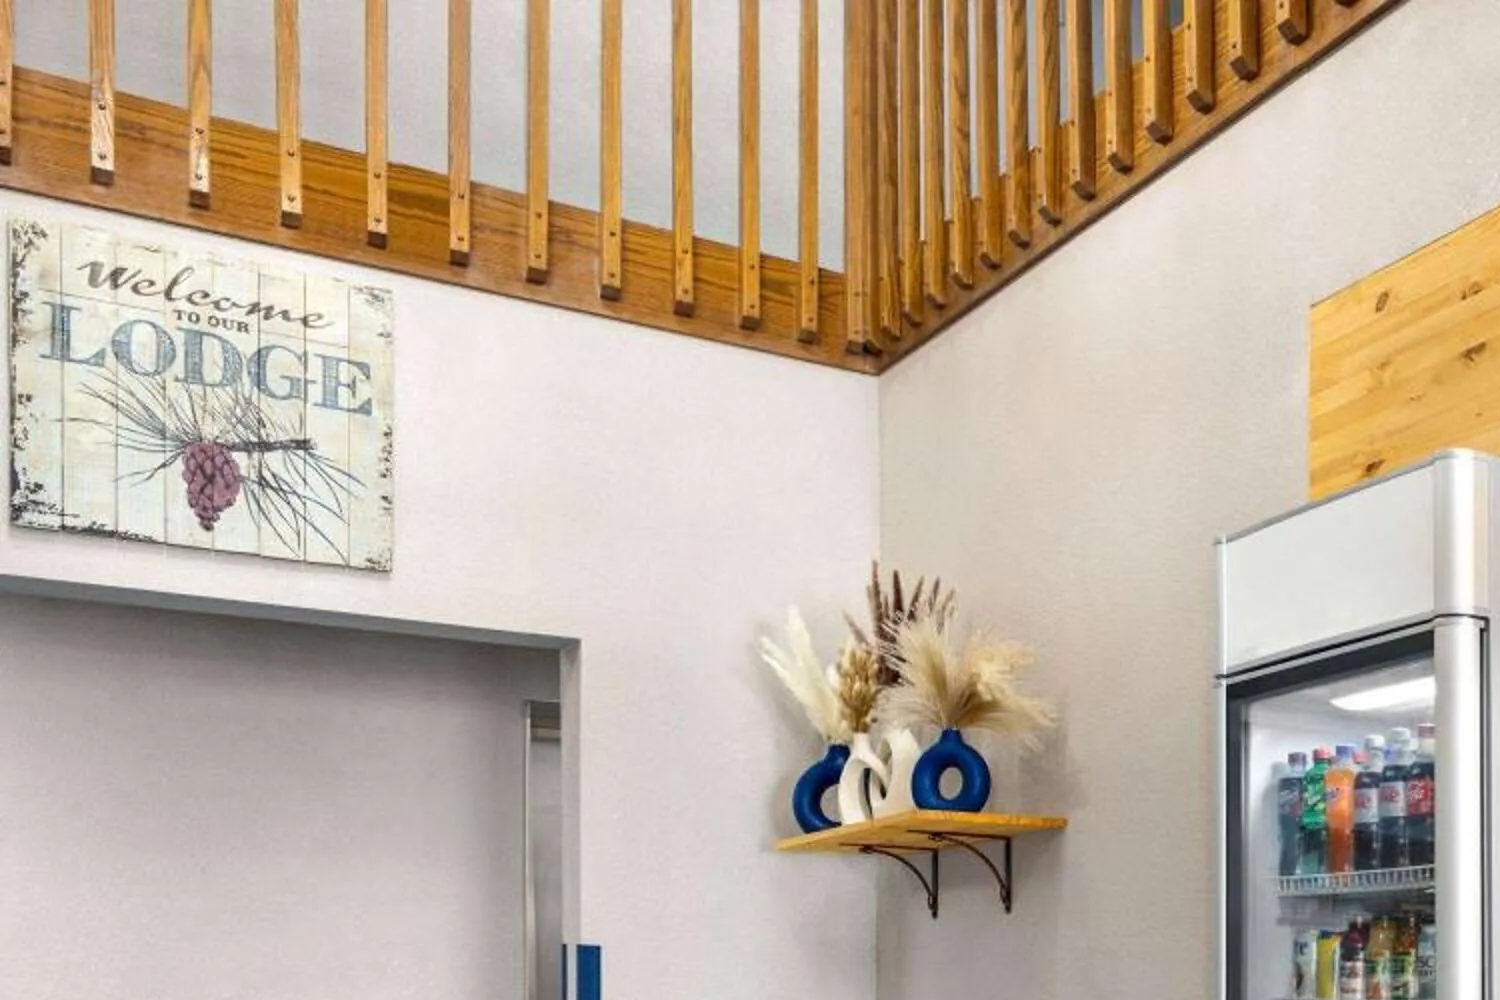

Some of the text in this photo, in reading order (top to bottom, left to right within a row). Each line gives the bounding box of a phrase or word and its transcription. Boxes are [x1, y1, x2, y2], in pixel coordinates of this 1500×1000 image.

[174, 308, 251, 335] TO OUR
[38, 300, 374, 417] LODGE
